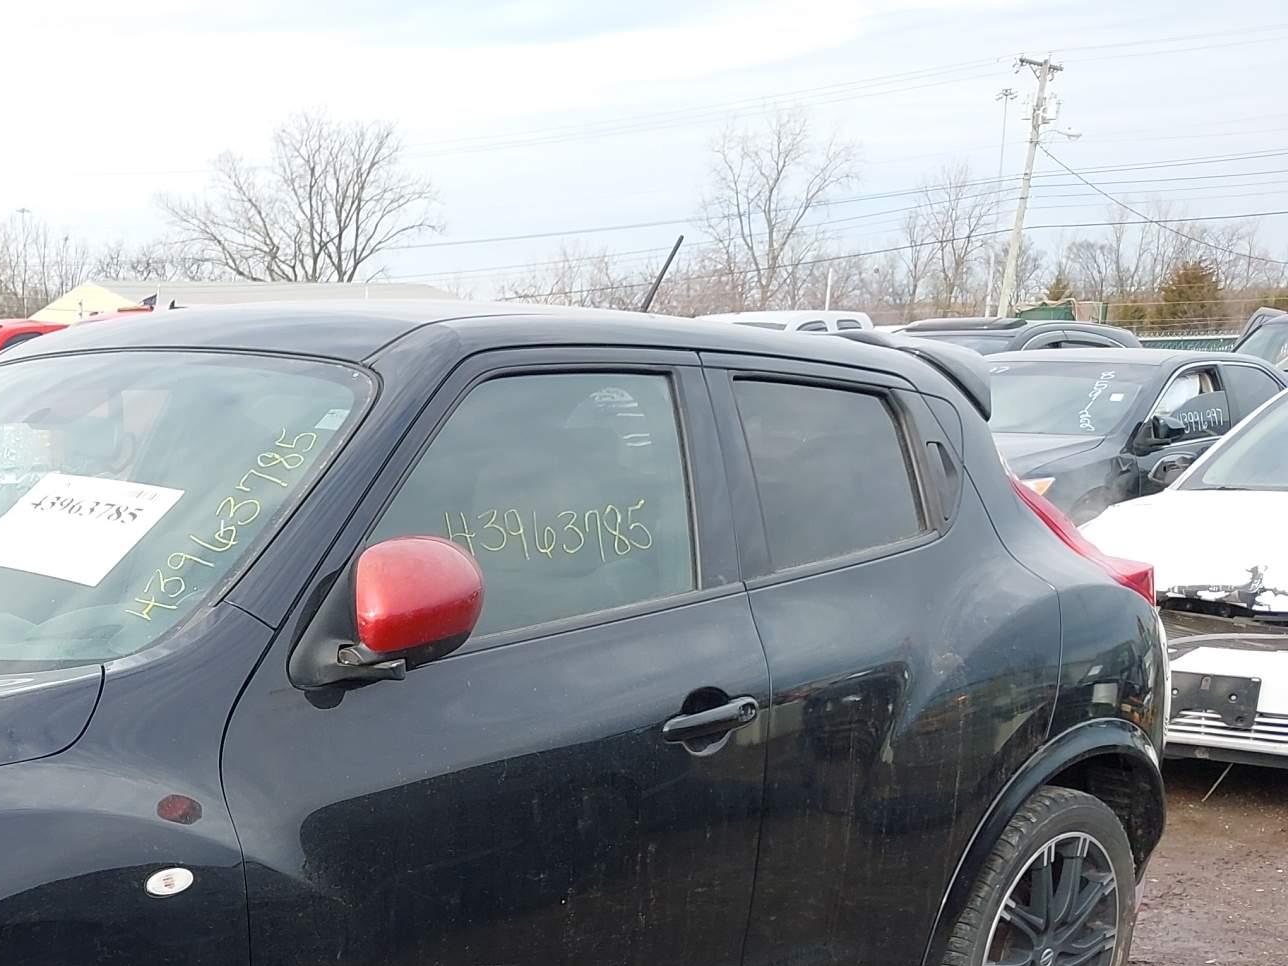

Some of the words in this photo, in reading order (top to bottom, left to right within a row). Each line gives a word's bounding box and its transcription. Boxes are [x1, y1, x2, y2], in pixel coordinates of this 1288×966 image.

[31, 496, 144, 524] 43963785
[125, 426, 316, 620] 43963785
[445, 499, 652, 563] 43963785
